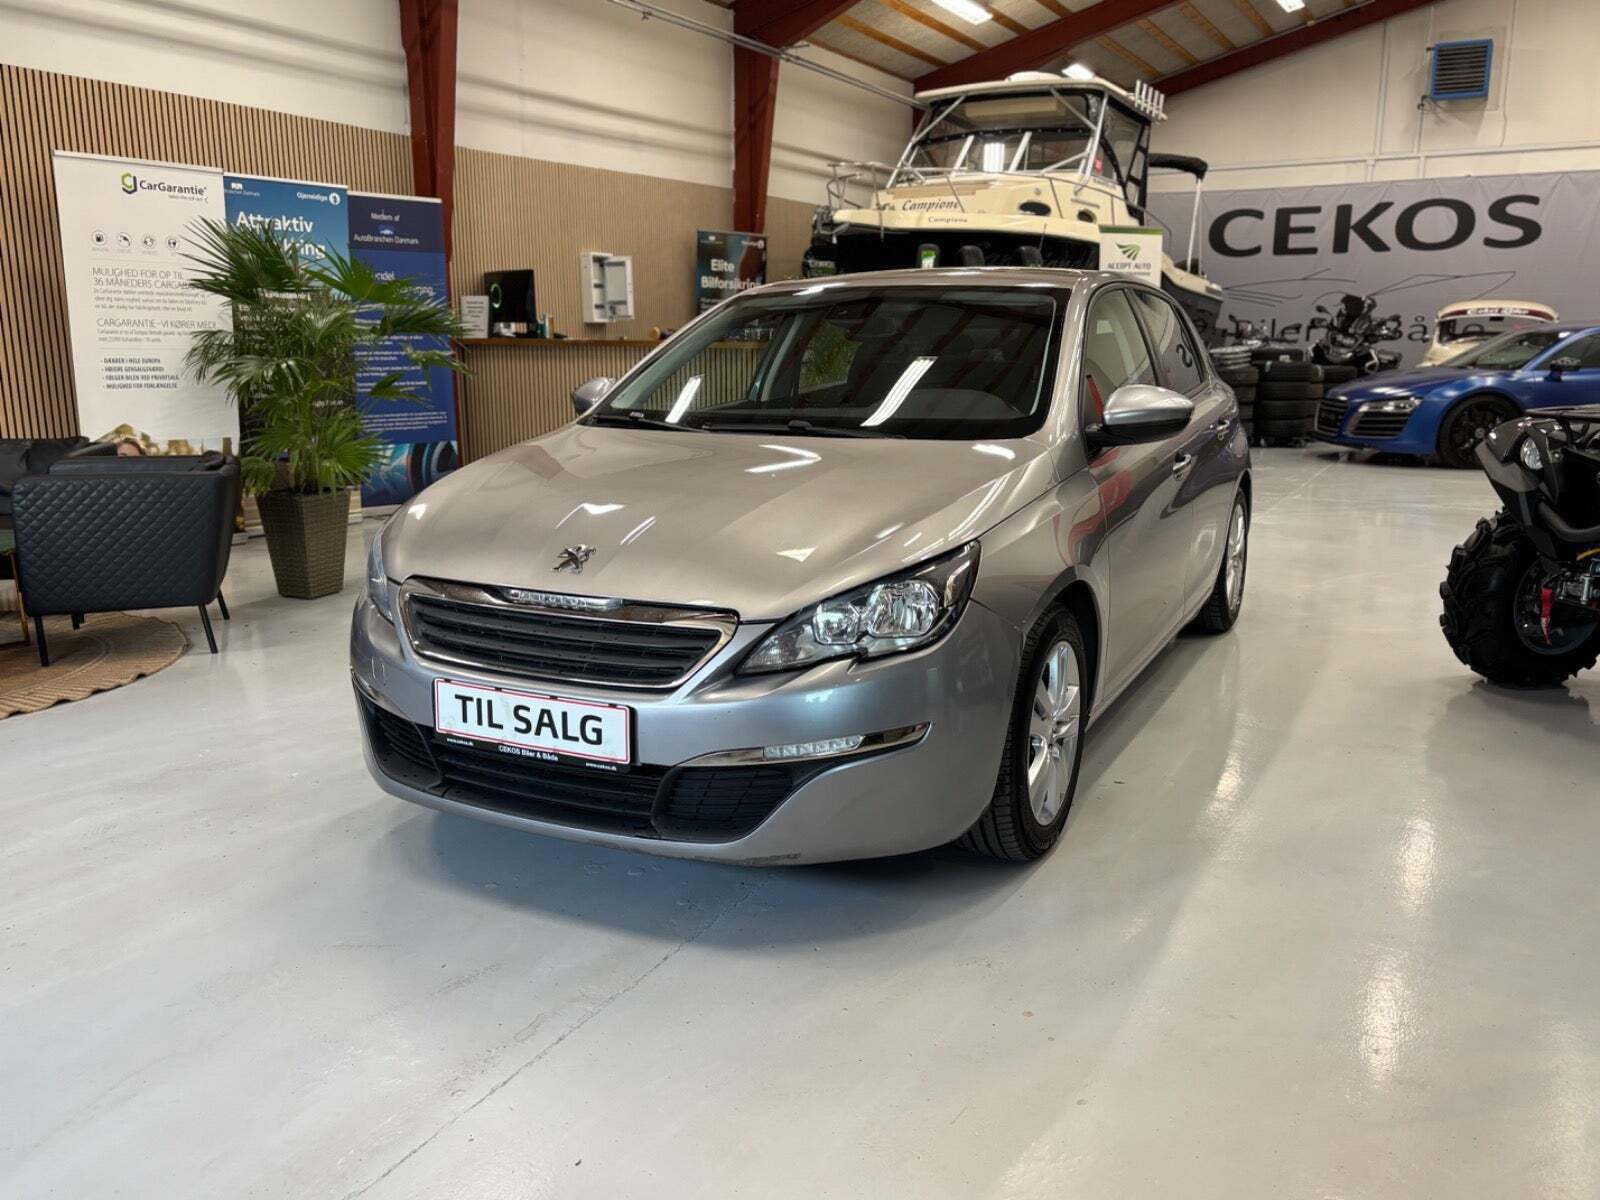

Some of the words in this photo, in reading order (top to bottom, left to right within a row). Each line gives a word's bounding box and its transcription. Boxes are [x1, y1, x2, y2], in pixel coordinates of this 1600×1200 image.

[139, 179, 205, 196] CarGarantie
[236, 211, 314, 233] Attraktiv
[1208, 194, 1543, 258] CEKOS
[711, 258, 735, 272] Elite
[1134, 262, 1152, 270] AUTO
[454, 693, 504, 730] TIL
[513, 704, 603, 746] SALG
